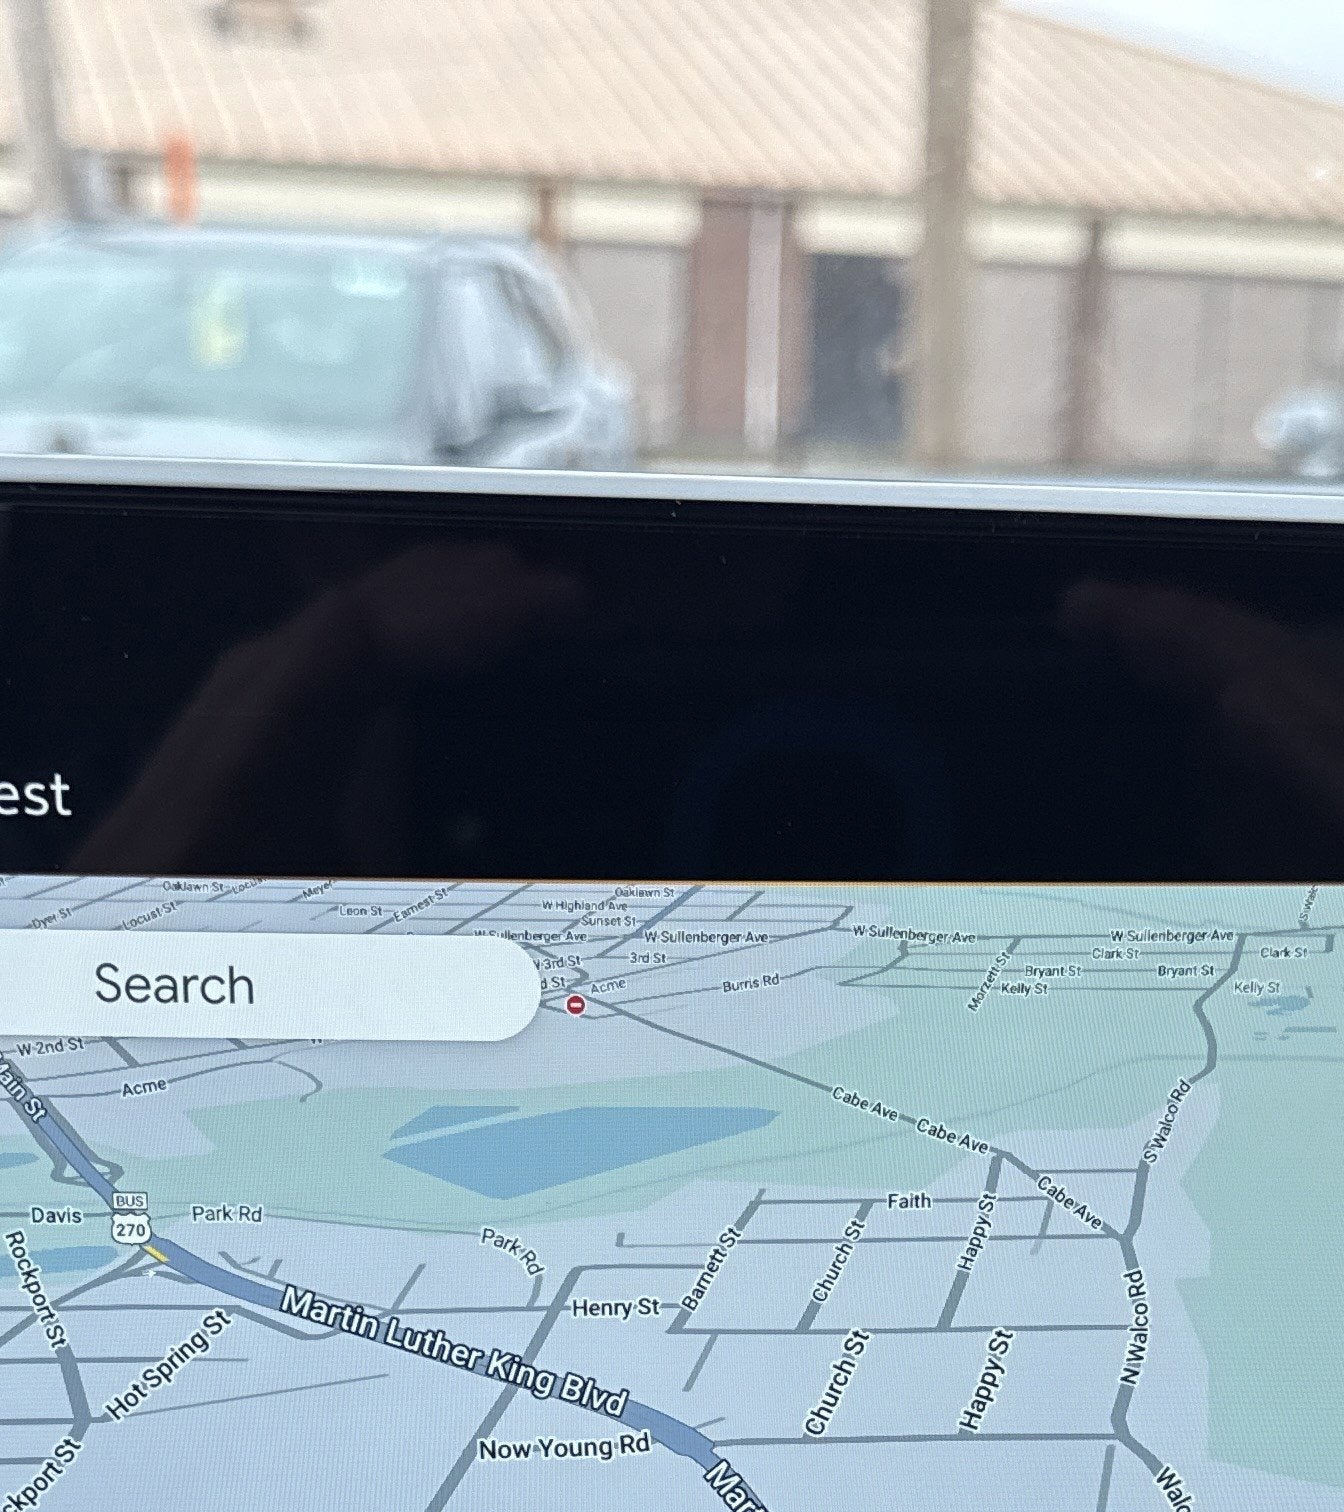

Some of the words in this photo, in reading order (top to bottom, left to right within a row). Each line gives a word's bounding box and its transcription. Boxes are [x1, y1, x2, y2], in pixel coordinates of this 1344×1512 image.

[163, 880, 208, 892] Oaklawn
[211, 881, 224, 892] St
[434, 887, 449, 901] St
[614, 887, 659, 898] Oaklawn
[663, 887, 674, 897] St
[370, 905, 383, 916] St
[542, 901, 553, 910] W
[555, 900, 605, 912] Highland
[608, 901, 628, 911] Ave
[31, 913, 58, 930] Dyer
[58, 907, 72, 919] St
[122, 906, 161, 930] Locust
[162, 902, 177, 914] St
[581, 916, 621, 927] Sunset
[623, 916, 637, 926] St
[644, 931, 658, 942] W
[660, 930, 740, 945] Sullenberger
[744, 931, 768, 942] Ave
[853, 926, 866, 936] W
[868, 925, 949, 944] Sullenberger
[951, 931, 976, 943] Ave
[1110, 930, 1123, 942] W
[1127, 930, 1208, 945] Sullenberger
[1210, 931, 1234, 942] Ave
[542, 958, 565, 969] 3rd
[567, 956, 581, 967] St
[629, 952, 649, 963] 3rd
[653, 952, 666, 963] St
[1092, 948, 1123, 960] Clark
[1126, 948, 1139, 959] St
[1260, 947, 1290, 959] Clark
[1294, 947, 1307, 958] St
[1025, 965, 1065, 977] Bryant
[1067, 966, 1081, 977] St
[1158, 965, 1197, 977] Bryant
[1200, 965, 1214, 976] St
[95, 963, 256, 1006] Search
[591, 978, 626, 994] Acme
[722, 977, 760, 992] Burris
[763, 973, 780, 987] Rd
[1001, 983, 1030, 997] Kelly
[1032, 983, 1048, 995] St
[1234, 981, 1264, 995] Kelly
[1267, 981, 1280, 993] St
[17, 1042, 33, 1056] W
[35, 1039, 65, 1055] 2nd
[67, 1037, 85, 1051] St
[122, 1078, 168, 1098] Acme
[23, 1098, 47, 1123] St
[832, 1087, 869, 1111] Cabe
[870, 1099, 899, 1121] Ave
[1143, 1149, 1157, 1164] S
[1150, 1103, 1179, 1152] Walco
[1170, 1079, 1192, 1105] Rd
[916, 1118, 957, 1145] Cabe
[958, 1133, 989, 1155] Ave
[116, 1194, 144, 1208] BUS
[887, 1193, 932, 1209] Faith
[1037, 1175, 1076, 1210] Cabe
[1072, 1201, 1103, 1230] Ave
[31, 1208, 82, 1225] Davis
[192, 1205, 234, 1222] Park
[238, 1205, 262, 1222] Rd
[116, 1223, 146, 1238] 270
[958, 1217, 993, 1271] Happy
[978, 1194, 997, 1217] St
[480, 1227, 519, 1256] Park
[518, 1250, 546, 1277] Rd
[812, 1240, 854, 1302] Church
[844, 1219, 865, 1241] St
[681, 1250, 729, 1312] Barnett
[719, 1226, 742, 1250] St
[6, 1229, 57, 1325] Rockport
[46, 1324, 67, 1351] St
[1124, 1271, 1147, 1299] Rd
[572, 1300, 633, 1320] Henry
[638, 1299, 660, 1316] St
[1123, 1302, 1149, 1364] Walco
[280, 1286, 380, 1339] Martin
[383, 1316, 484, 1371] Luther
[486, 1348, 556, 1399] King
[560, 1371, 630, 1418] Blvd
[106, 1382, 147, 1421] Hot
[143, 1328, 209, 1390] Spring
[202, 1309, 232, 1338] St
[805, 1358, 855, 1437] Church
[844, 1329, 871, 1355] St
[958, 1357, 1005, 1432] Happy
[988, 1329, 1015, 1354] St
[1120, 1367, 1140, 1385] N
[54, 1437, 83, 1466] St
[479, 1439, 530, 1459] Now
[538, 1437, 613, 1460] Young
[620, 1433, 650, 1453] Rd
